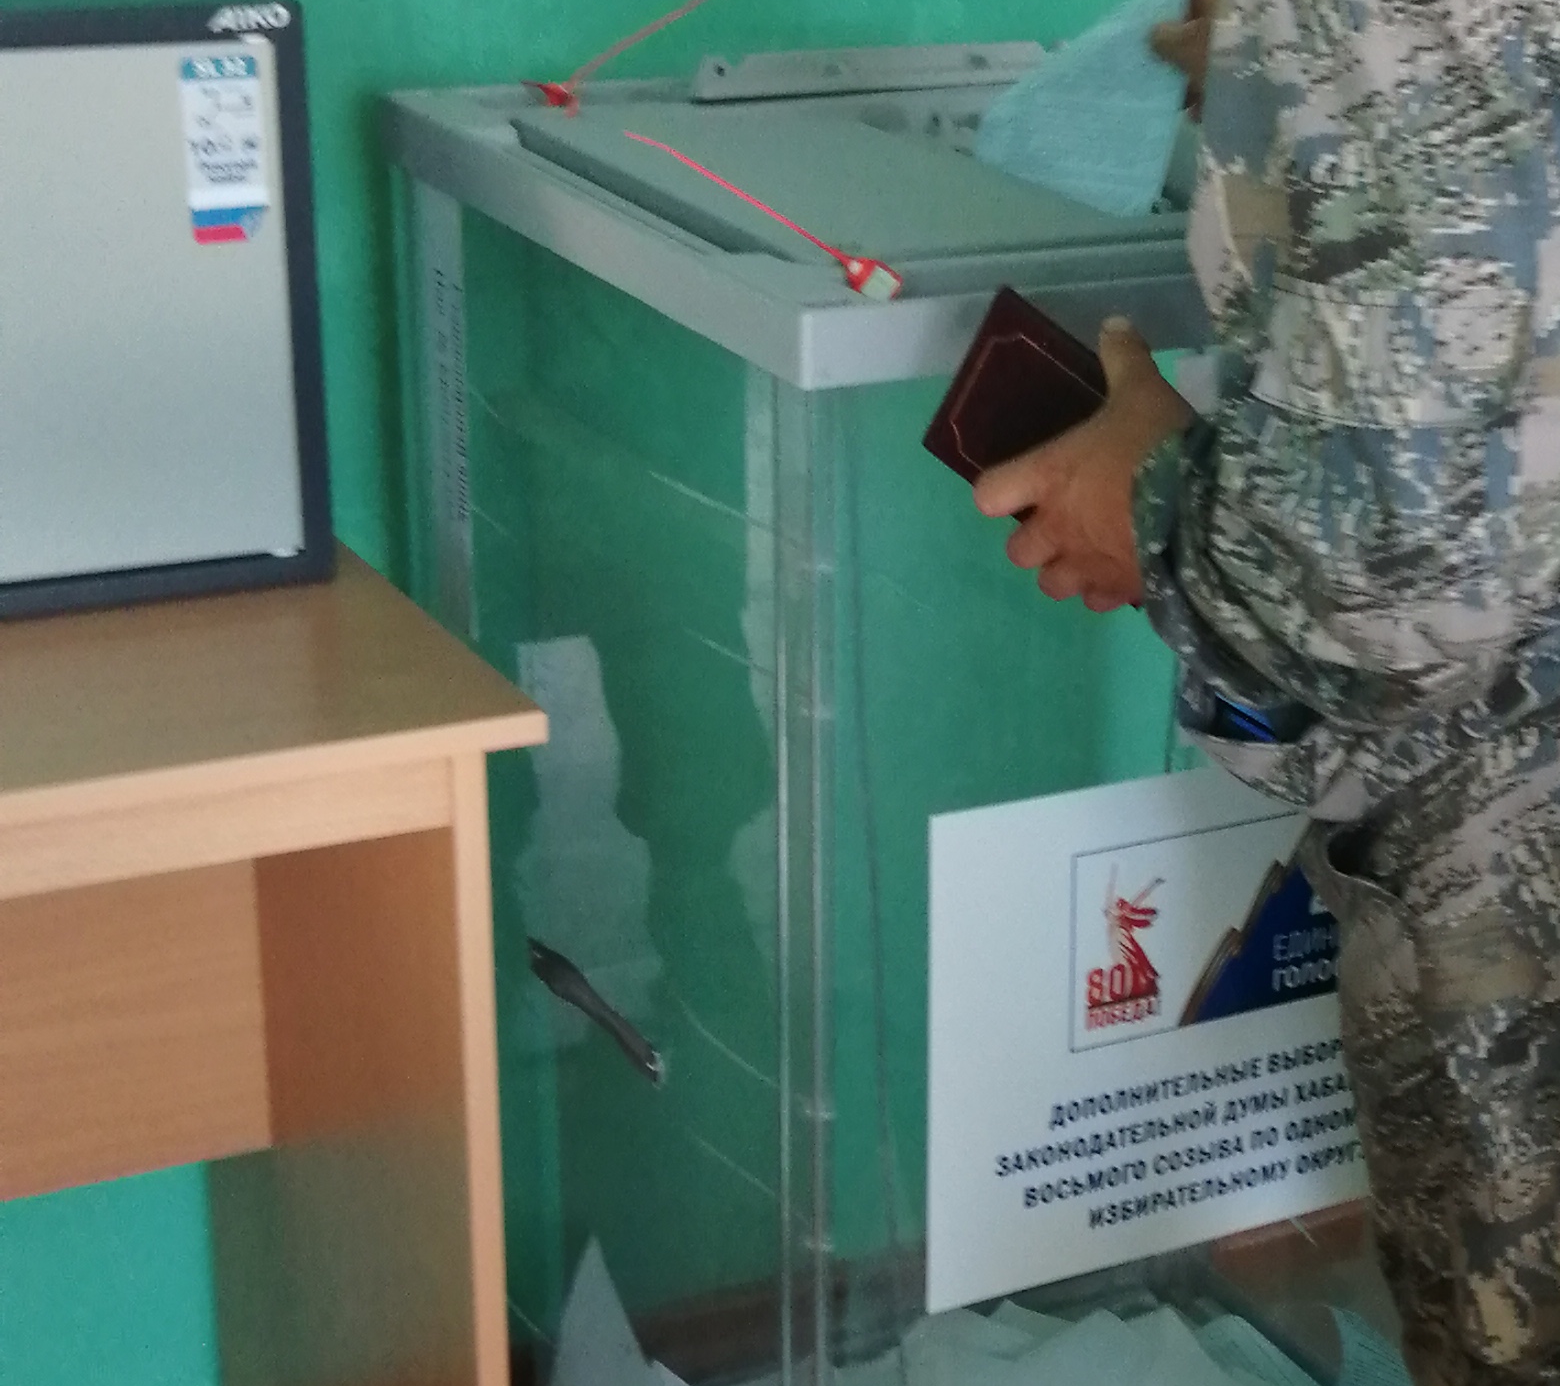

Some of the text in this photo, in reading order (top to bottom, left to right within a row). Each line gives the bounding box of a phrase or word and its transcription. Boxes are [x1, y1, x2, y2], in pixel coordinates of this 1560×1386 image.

[1086, 963, 1127, 1009] 80
[994, 1073, 1352, 1178] ЗАКОНОДАТЕЛЬНОЙ ДУМЫ ХАБА
[1048, 1056, 1263, 1131] ДОПОЛНИТЕЛЬНЫЕ
[1023, 1159, 1147, 1210] ВОСЬМОГО
[1152, 1135, 1245, 1176] СОЗЫВА
[1250, 1126, 1279, 1152] ПО
[1088, 1140, 1365, 1230] ИЗБИРАТЕЛЬНОМУ ОКРУГ
